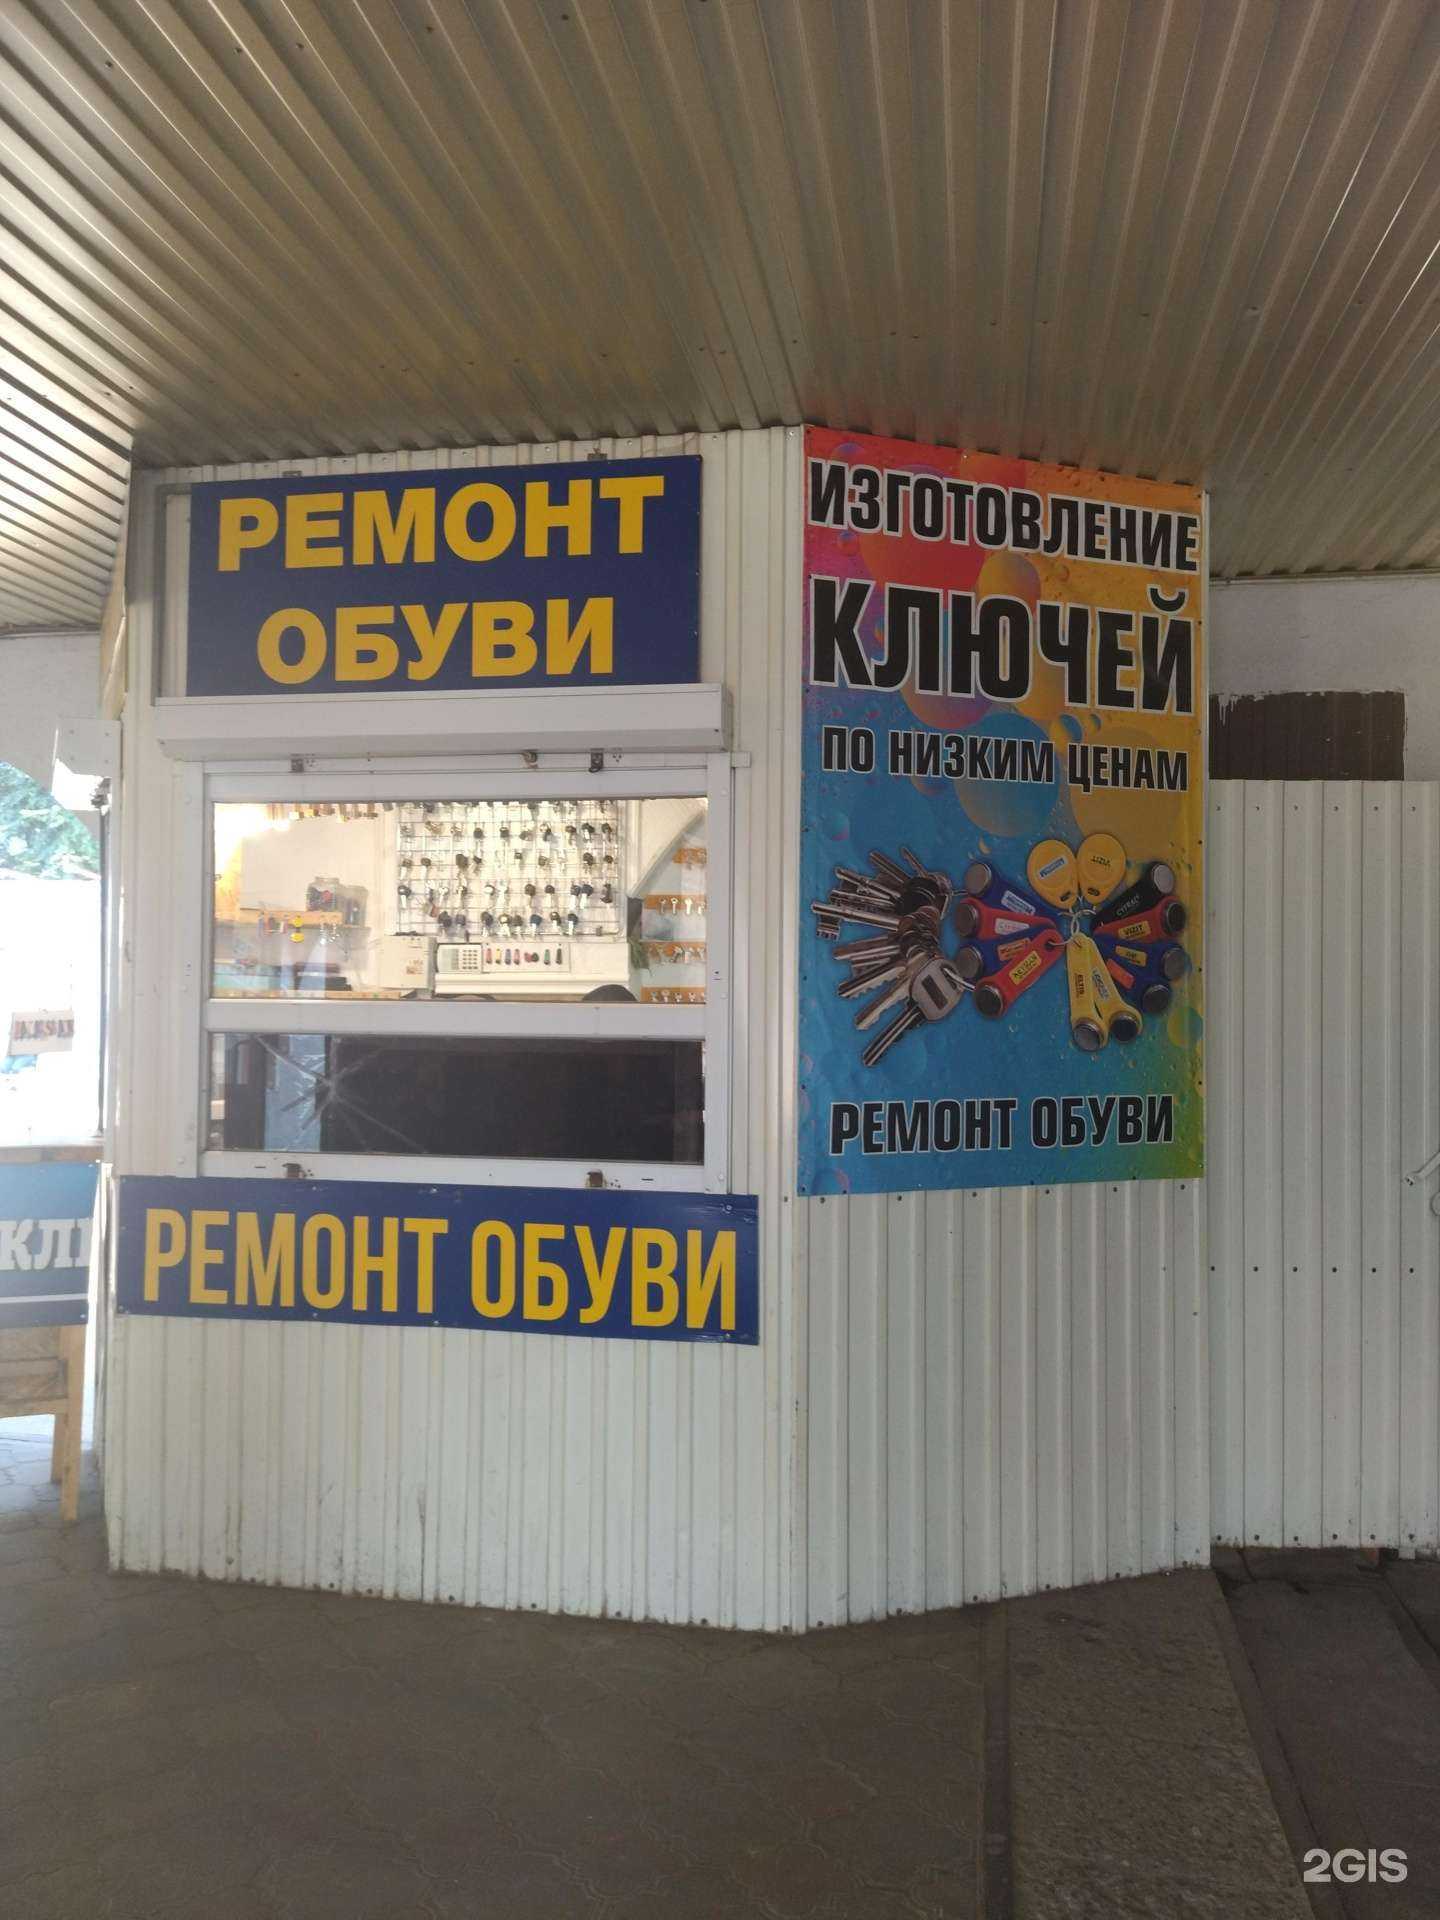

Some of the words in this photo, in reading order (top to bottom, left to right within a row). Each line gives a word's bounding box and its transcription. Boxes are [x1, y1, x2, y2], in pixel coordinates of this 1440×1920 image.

[218, 475, 665, 572] РЕМОНТ
[807, 457, 1200, 575] ИЗГОТОВЛЕНИЕ
[257, 597, 614, 684] ОБУВИ
[809, 574, 1194, 716] КЛЮЧЕЙ
[822, 725, 875, 774] ПО
[888, 729, 1055, 785] НИЗКИМ
[1068, 741, 1189, 794] ЦЕНАМ
[829, 1097, 1017, 1157] РЕМОНТ
[1031, 1094, 1175, 1150] ОБУВИ
[144, 1208, 448, 1314] РЕМОНТ
[471, 1219, 737, 1332] ОБУВИ
